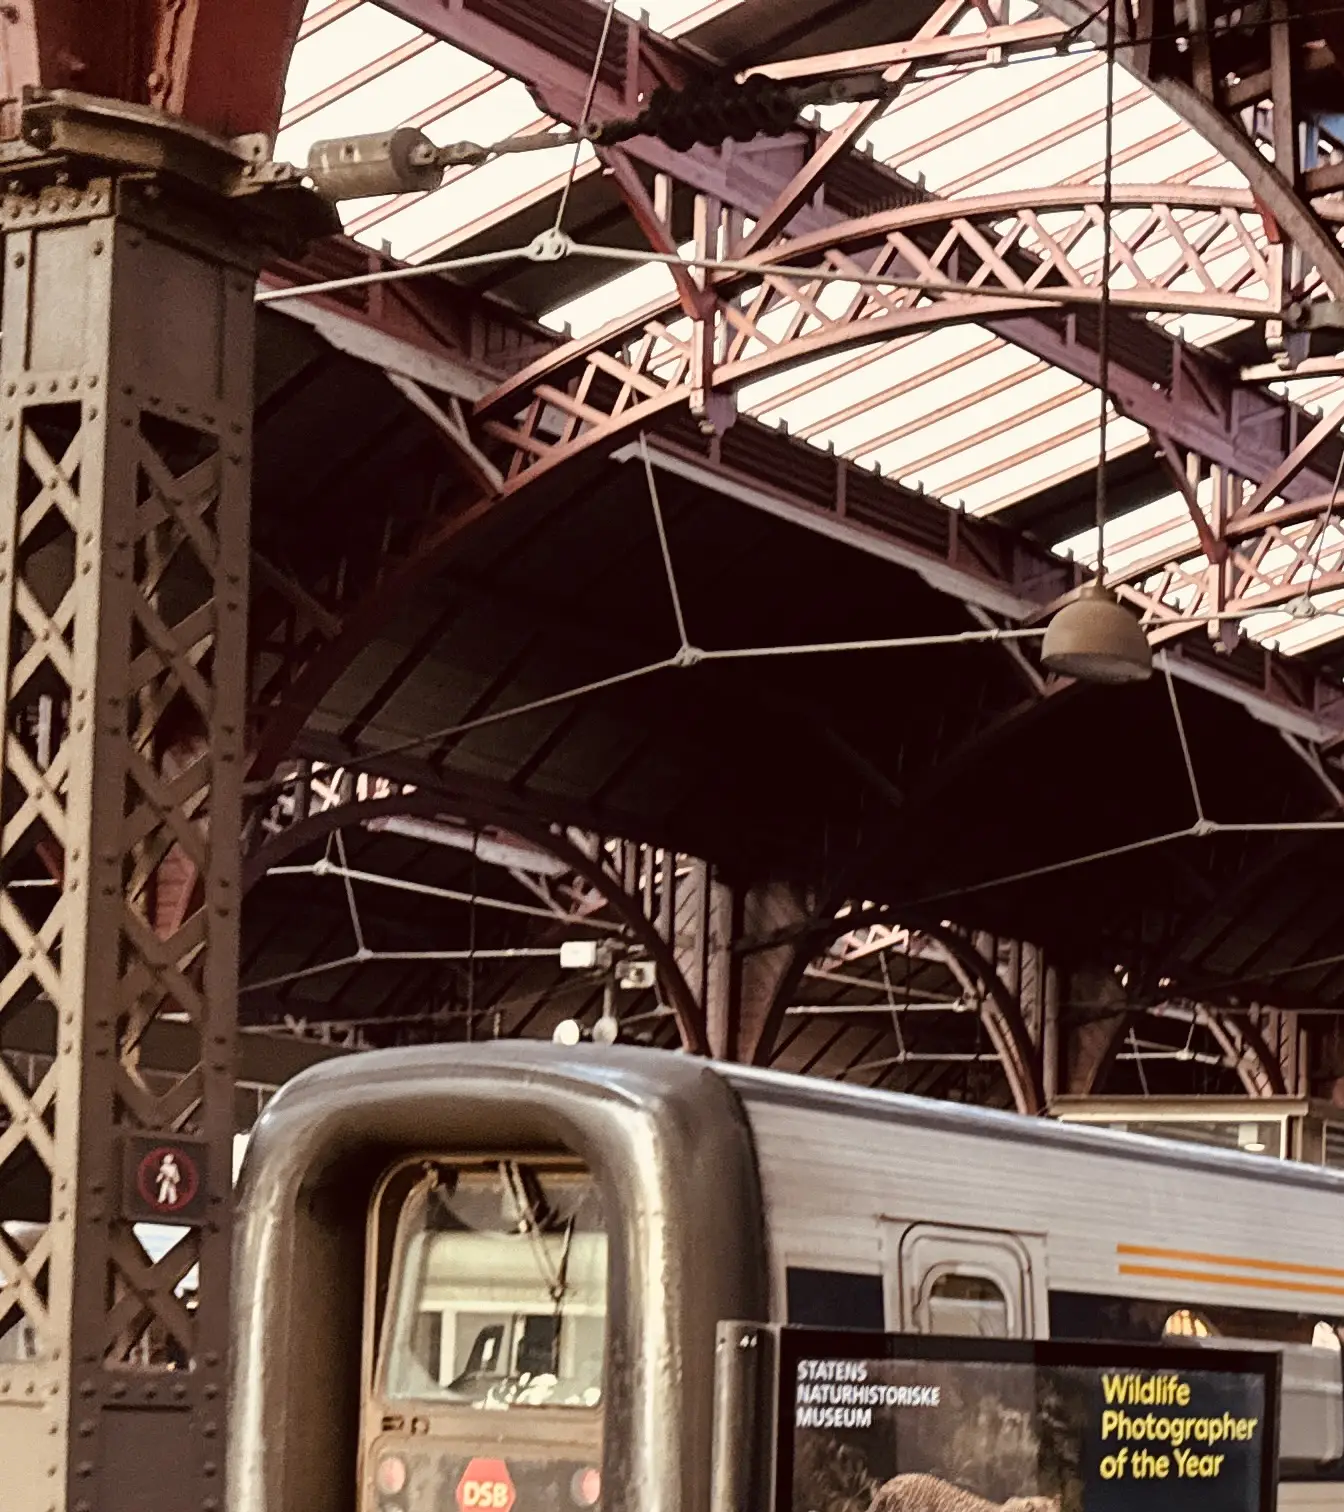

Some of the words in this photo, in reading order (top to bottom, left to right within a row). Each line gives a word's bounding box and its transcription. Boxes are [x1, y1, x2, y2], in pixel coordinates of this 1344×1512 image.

[797, 1359, 868, 1382] STATENS
[796, 1383, 941, 1407] NATURHISTORISKE
[1101, 1373, 1191, 1406] Wildlife
[795, 1407, 872, 1428] MUSEUM
[1101, 1409, 1258, 1447] Photographer
[1099, 1447, 1129, 1480] of
[1131, 1448, 1171, 1479] the
[1172, 1448, 1225, 1479] Year
[463, 1480, 509, 1508] DSB
